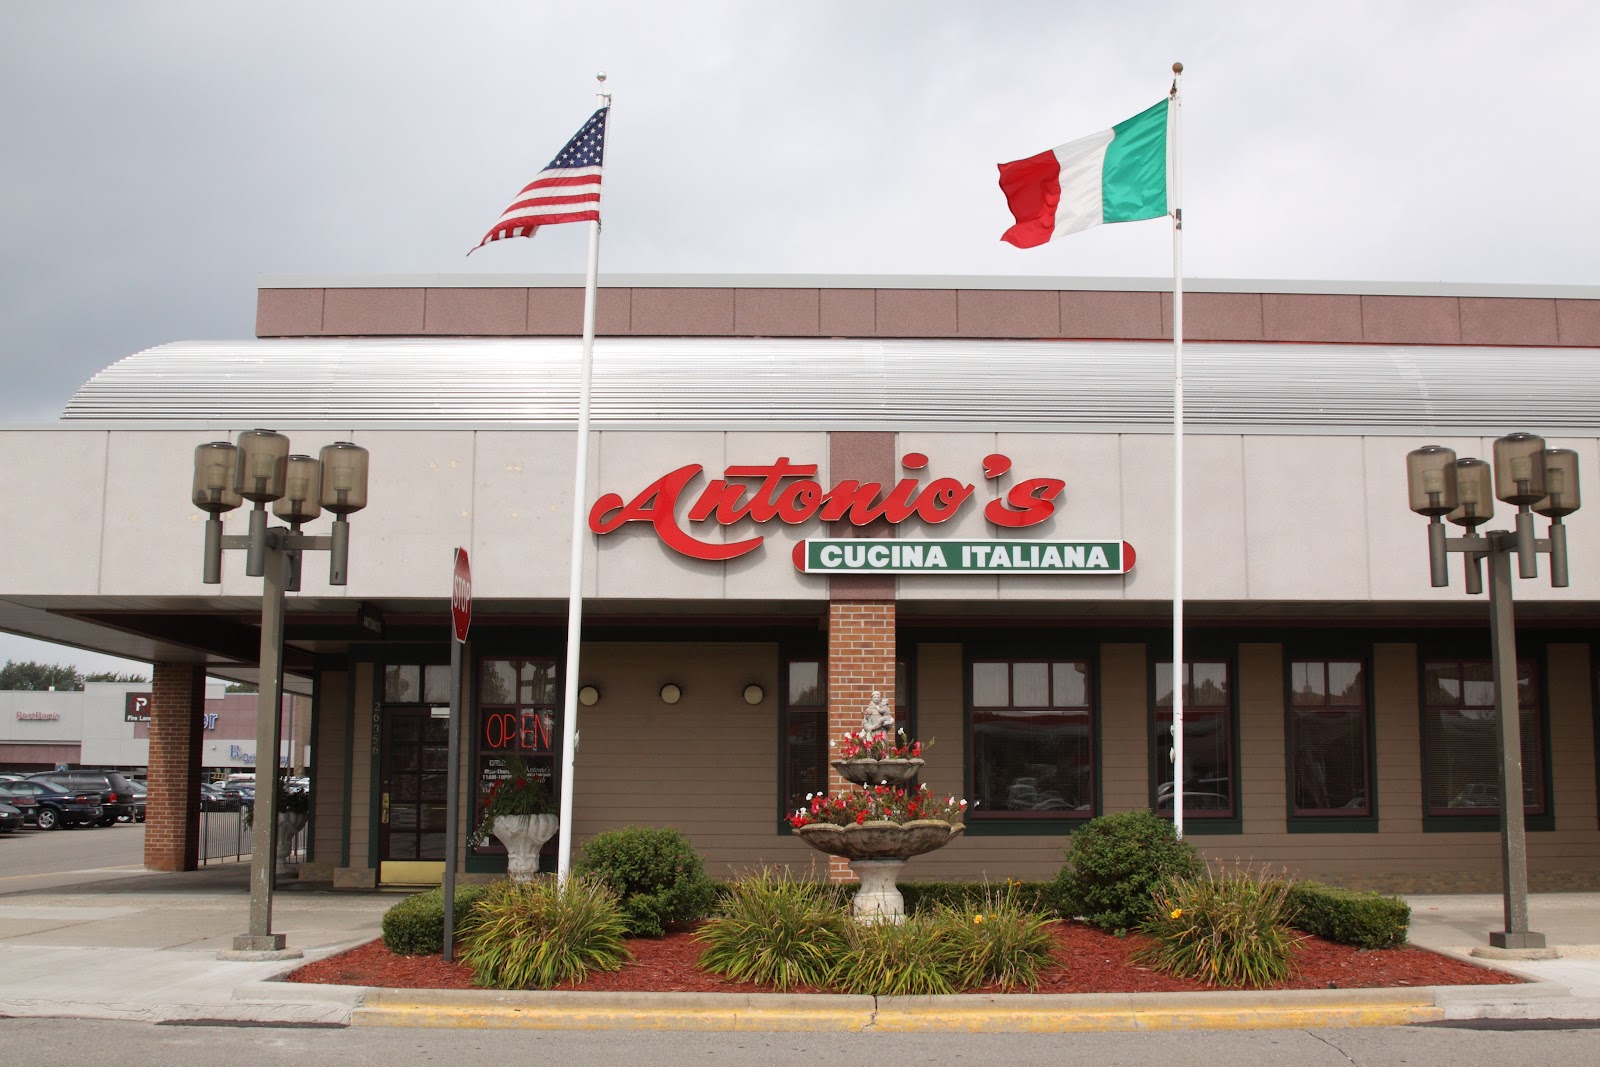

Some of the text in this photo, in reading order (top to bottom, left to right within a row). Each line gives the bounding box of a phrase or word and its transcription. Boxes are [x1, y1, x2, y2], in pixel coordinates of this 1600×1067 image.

[589, 453, 1066, 560] Antonio's
[820, 545, 1109, 568] CUCINA ITALIANA
[453, 574, 471, 614] STOP
[372, 701, 381, 755] 26356
[486, 713, 549, 749] OPEN
